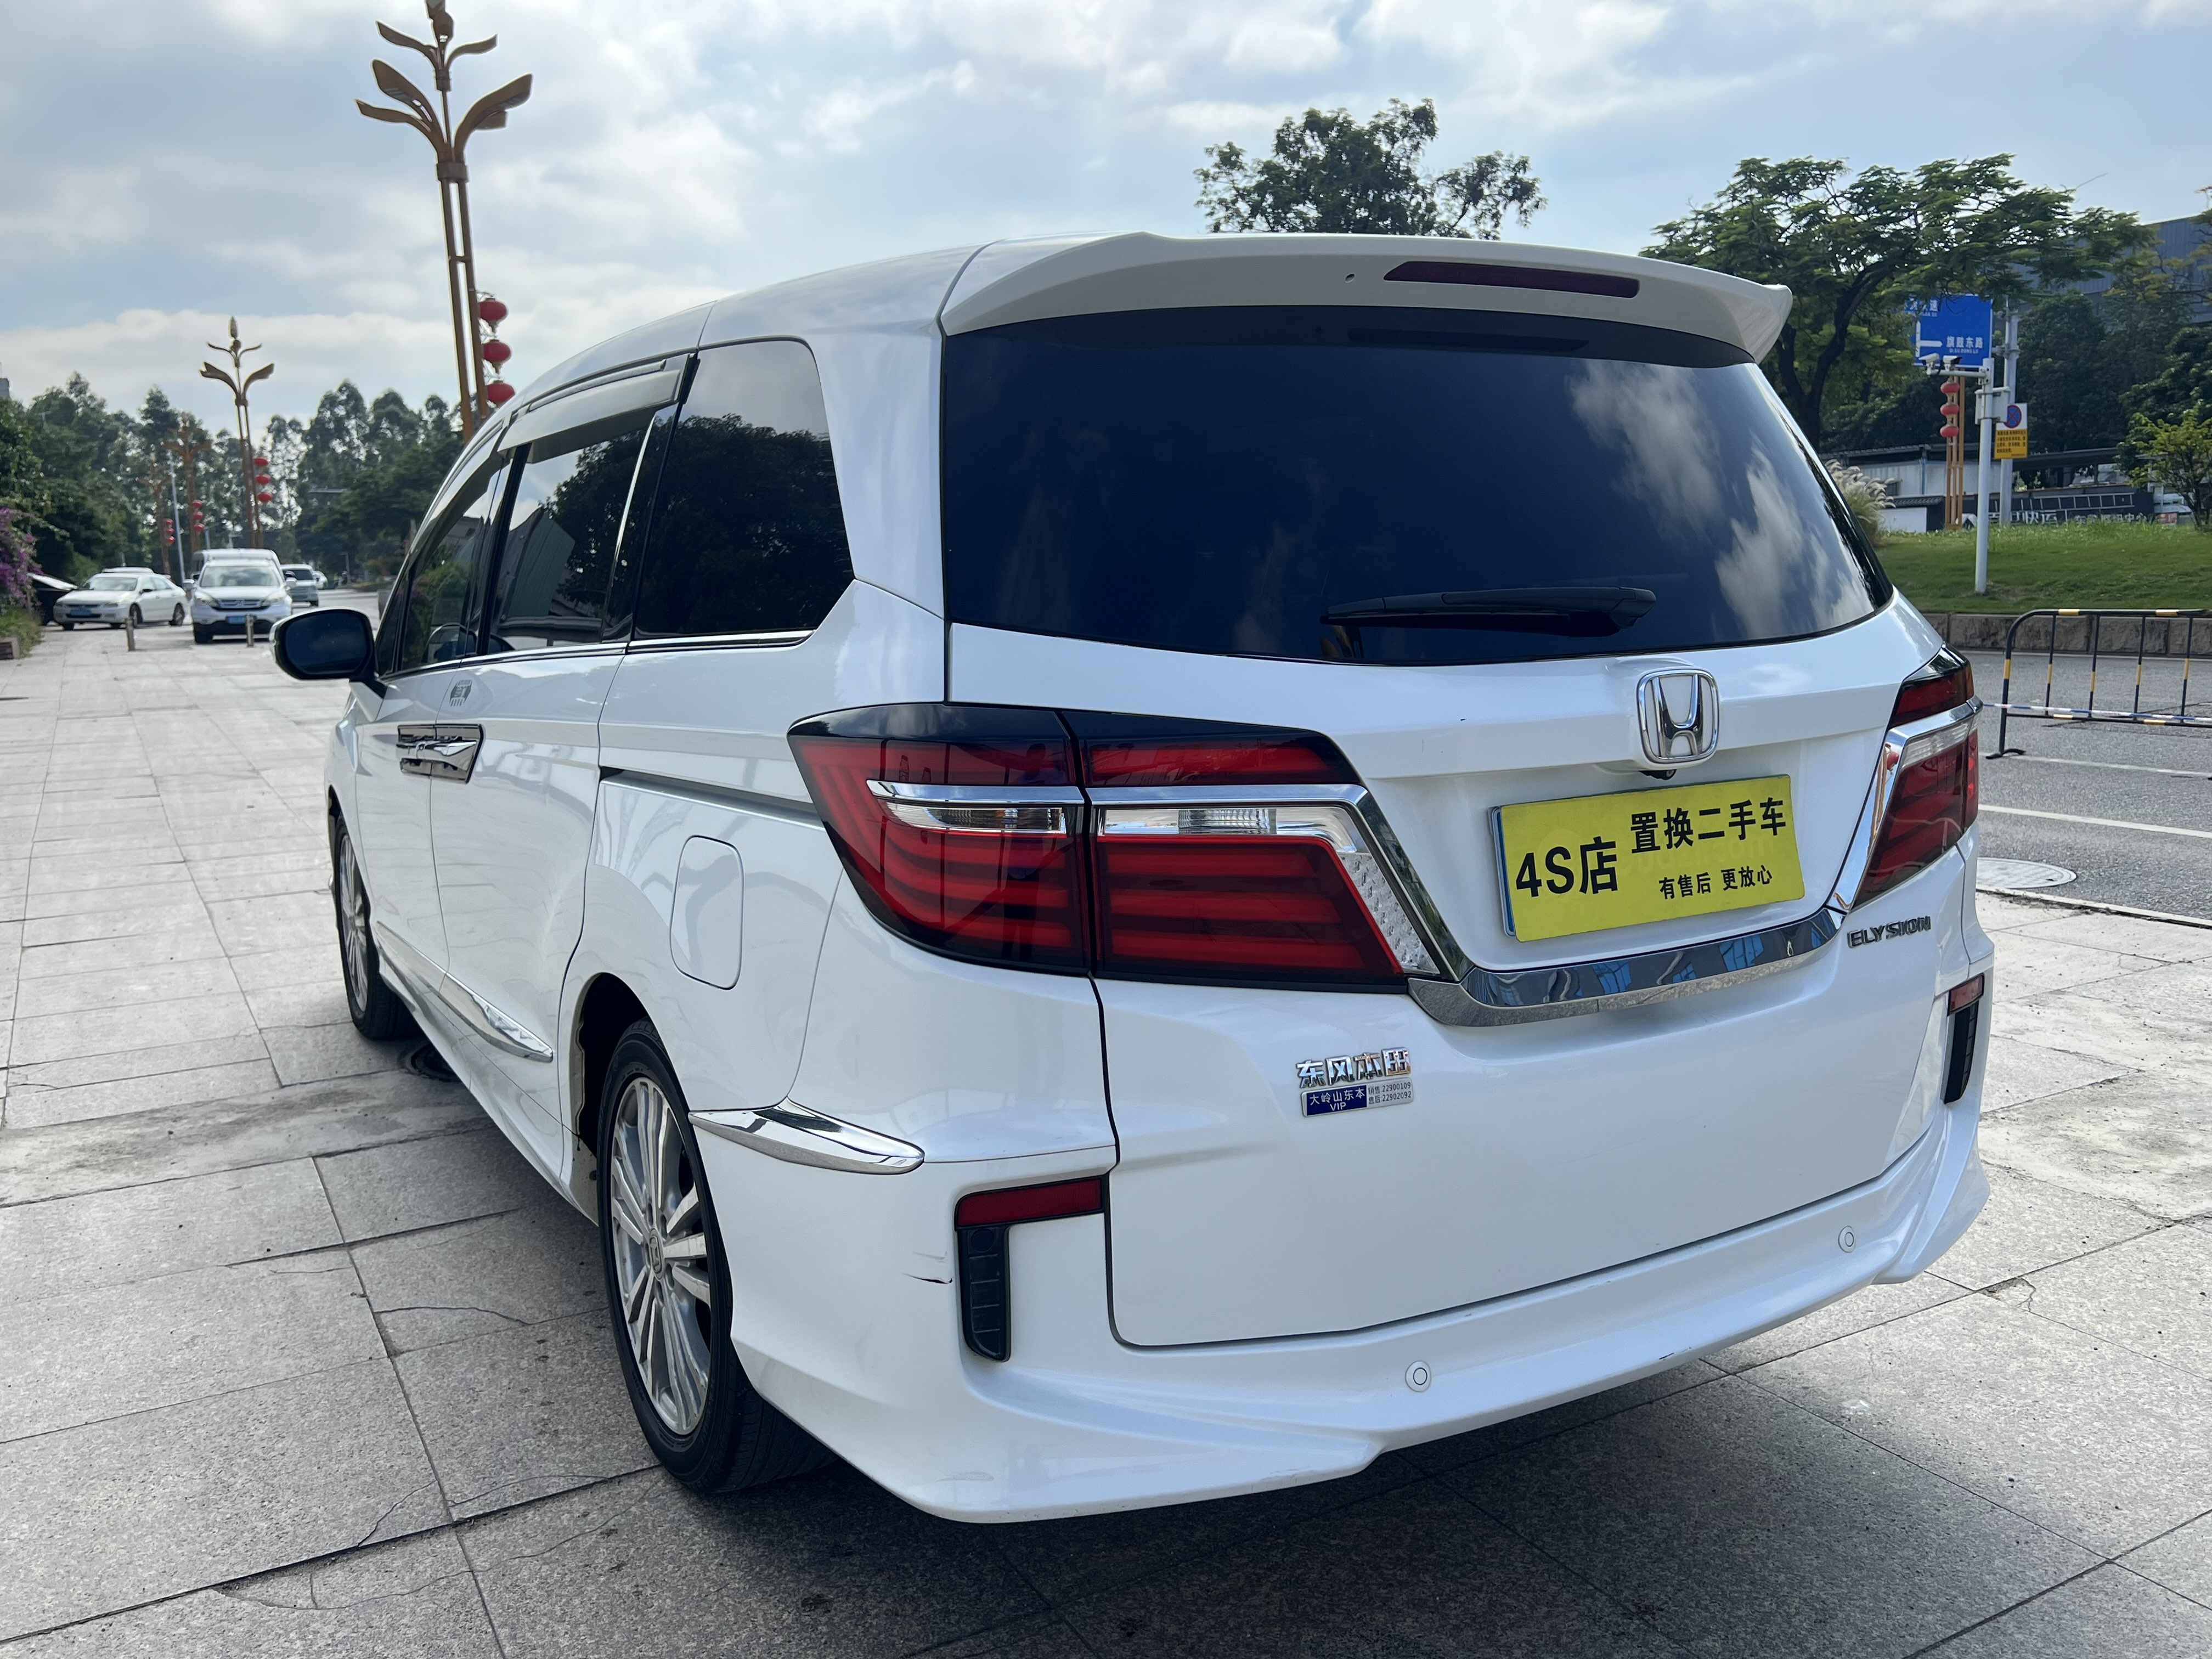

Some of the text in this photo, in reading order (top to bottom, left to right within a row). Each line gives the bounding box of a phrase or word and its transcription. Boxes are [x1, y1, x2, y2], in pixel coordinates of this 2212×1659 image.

[1630, 797, 1787, 854] 置换二手车
[1515, 836, 1619, 898] 4S店
[1658, 864, 1773, 900] 有售后 更放心
[1847, 915, 1932, 949] ELYSION
[1295, 1046, 1412, 1088] 东风本田
[1309, 1087, 1365, 1105] 大岭山东本
[1329, 1102, 1347, 1111] VIP
